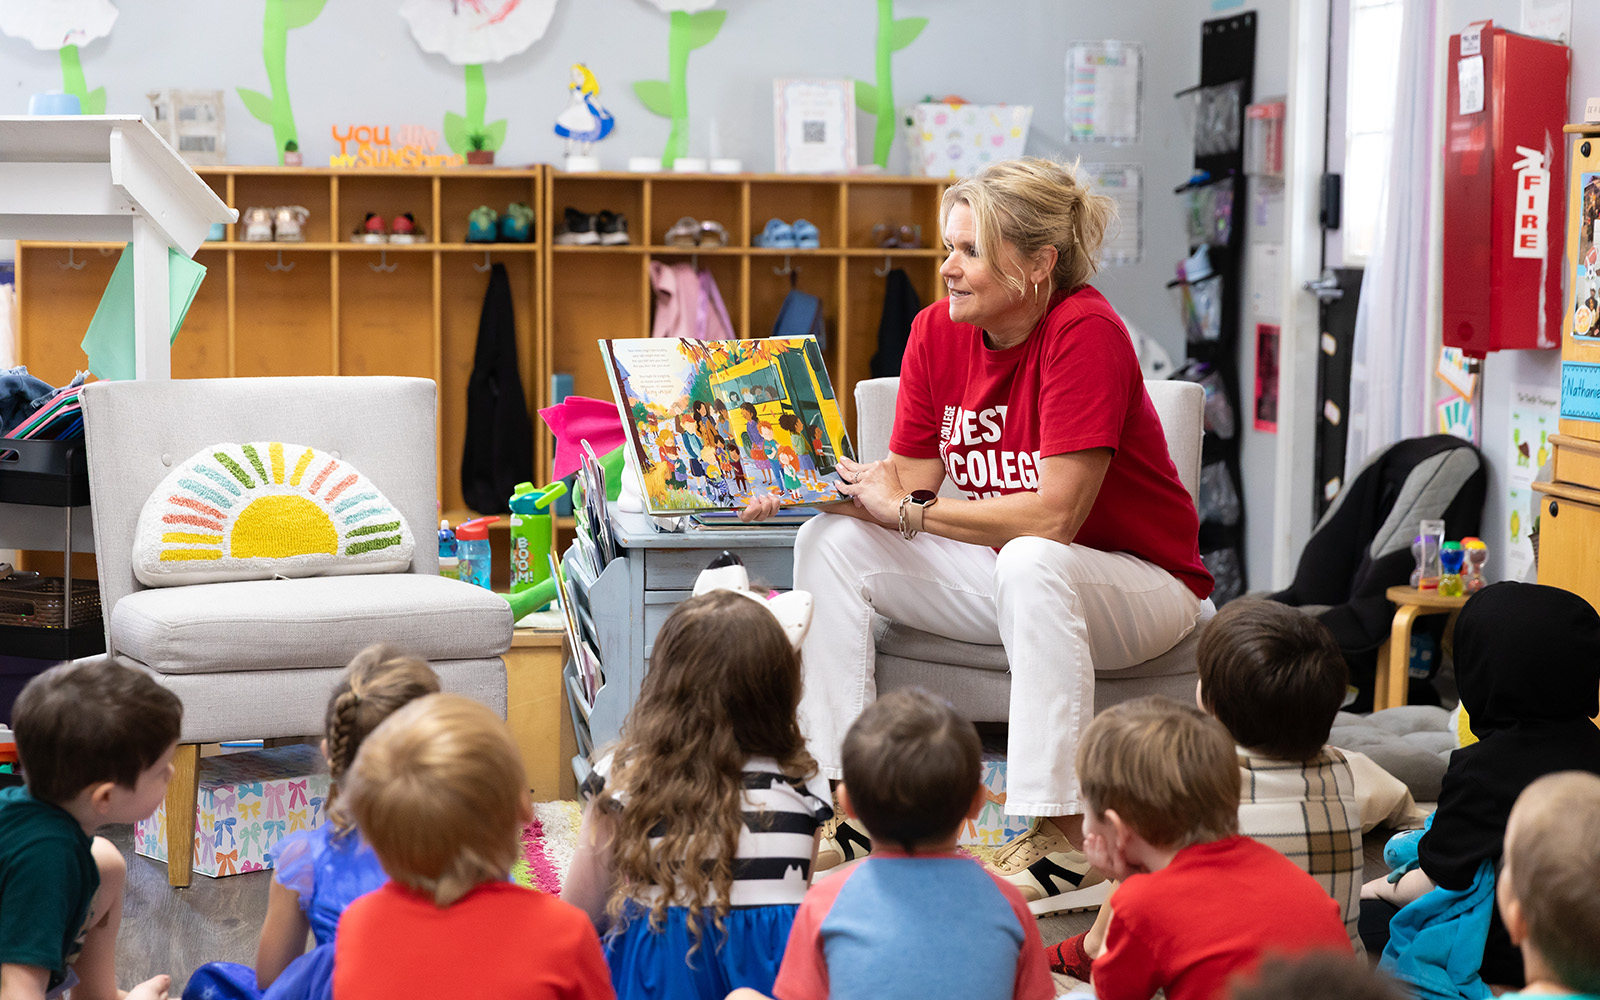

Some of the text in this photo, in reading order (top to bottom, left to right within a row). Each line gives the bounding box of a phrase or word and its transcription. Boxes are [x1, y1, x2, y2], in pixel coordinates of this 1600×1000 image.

[1520, 175, 1541, 249] FIRE
[940, 405, 956, 440] COLLEGE
[517, 536, 534, 583] BOOM!
